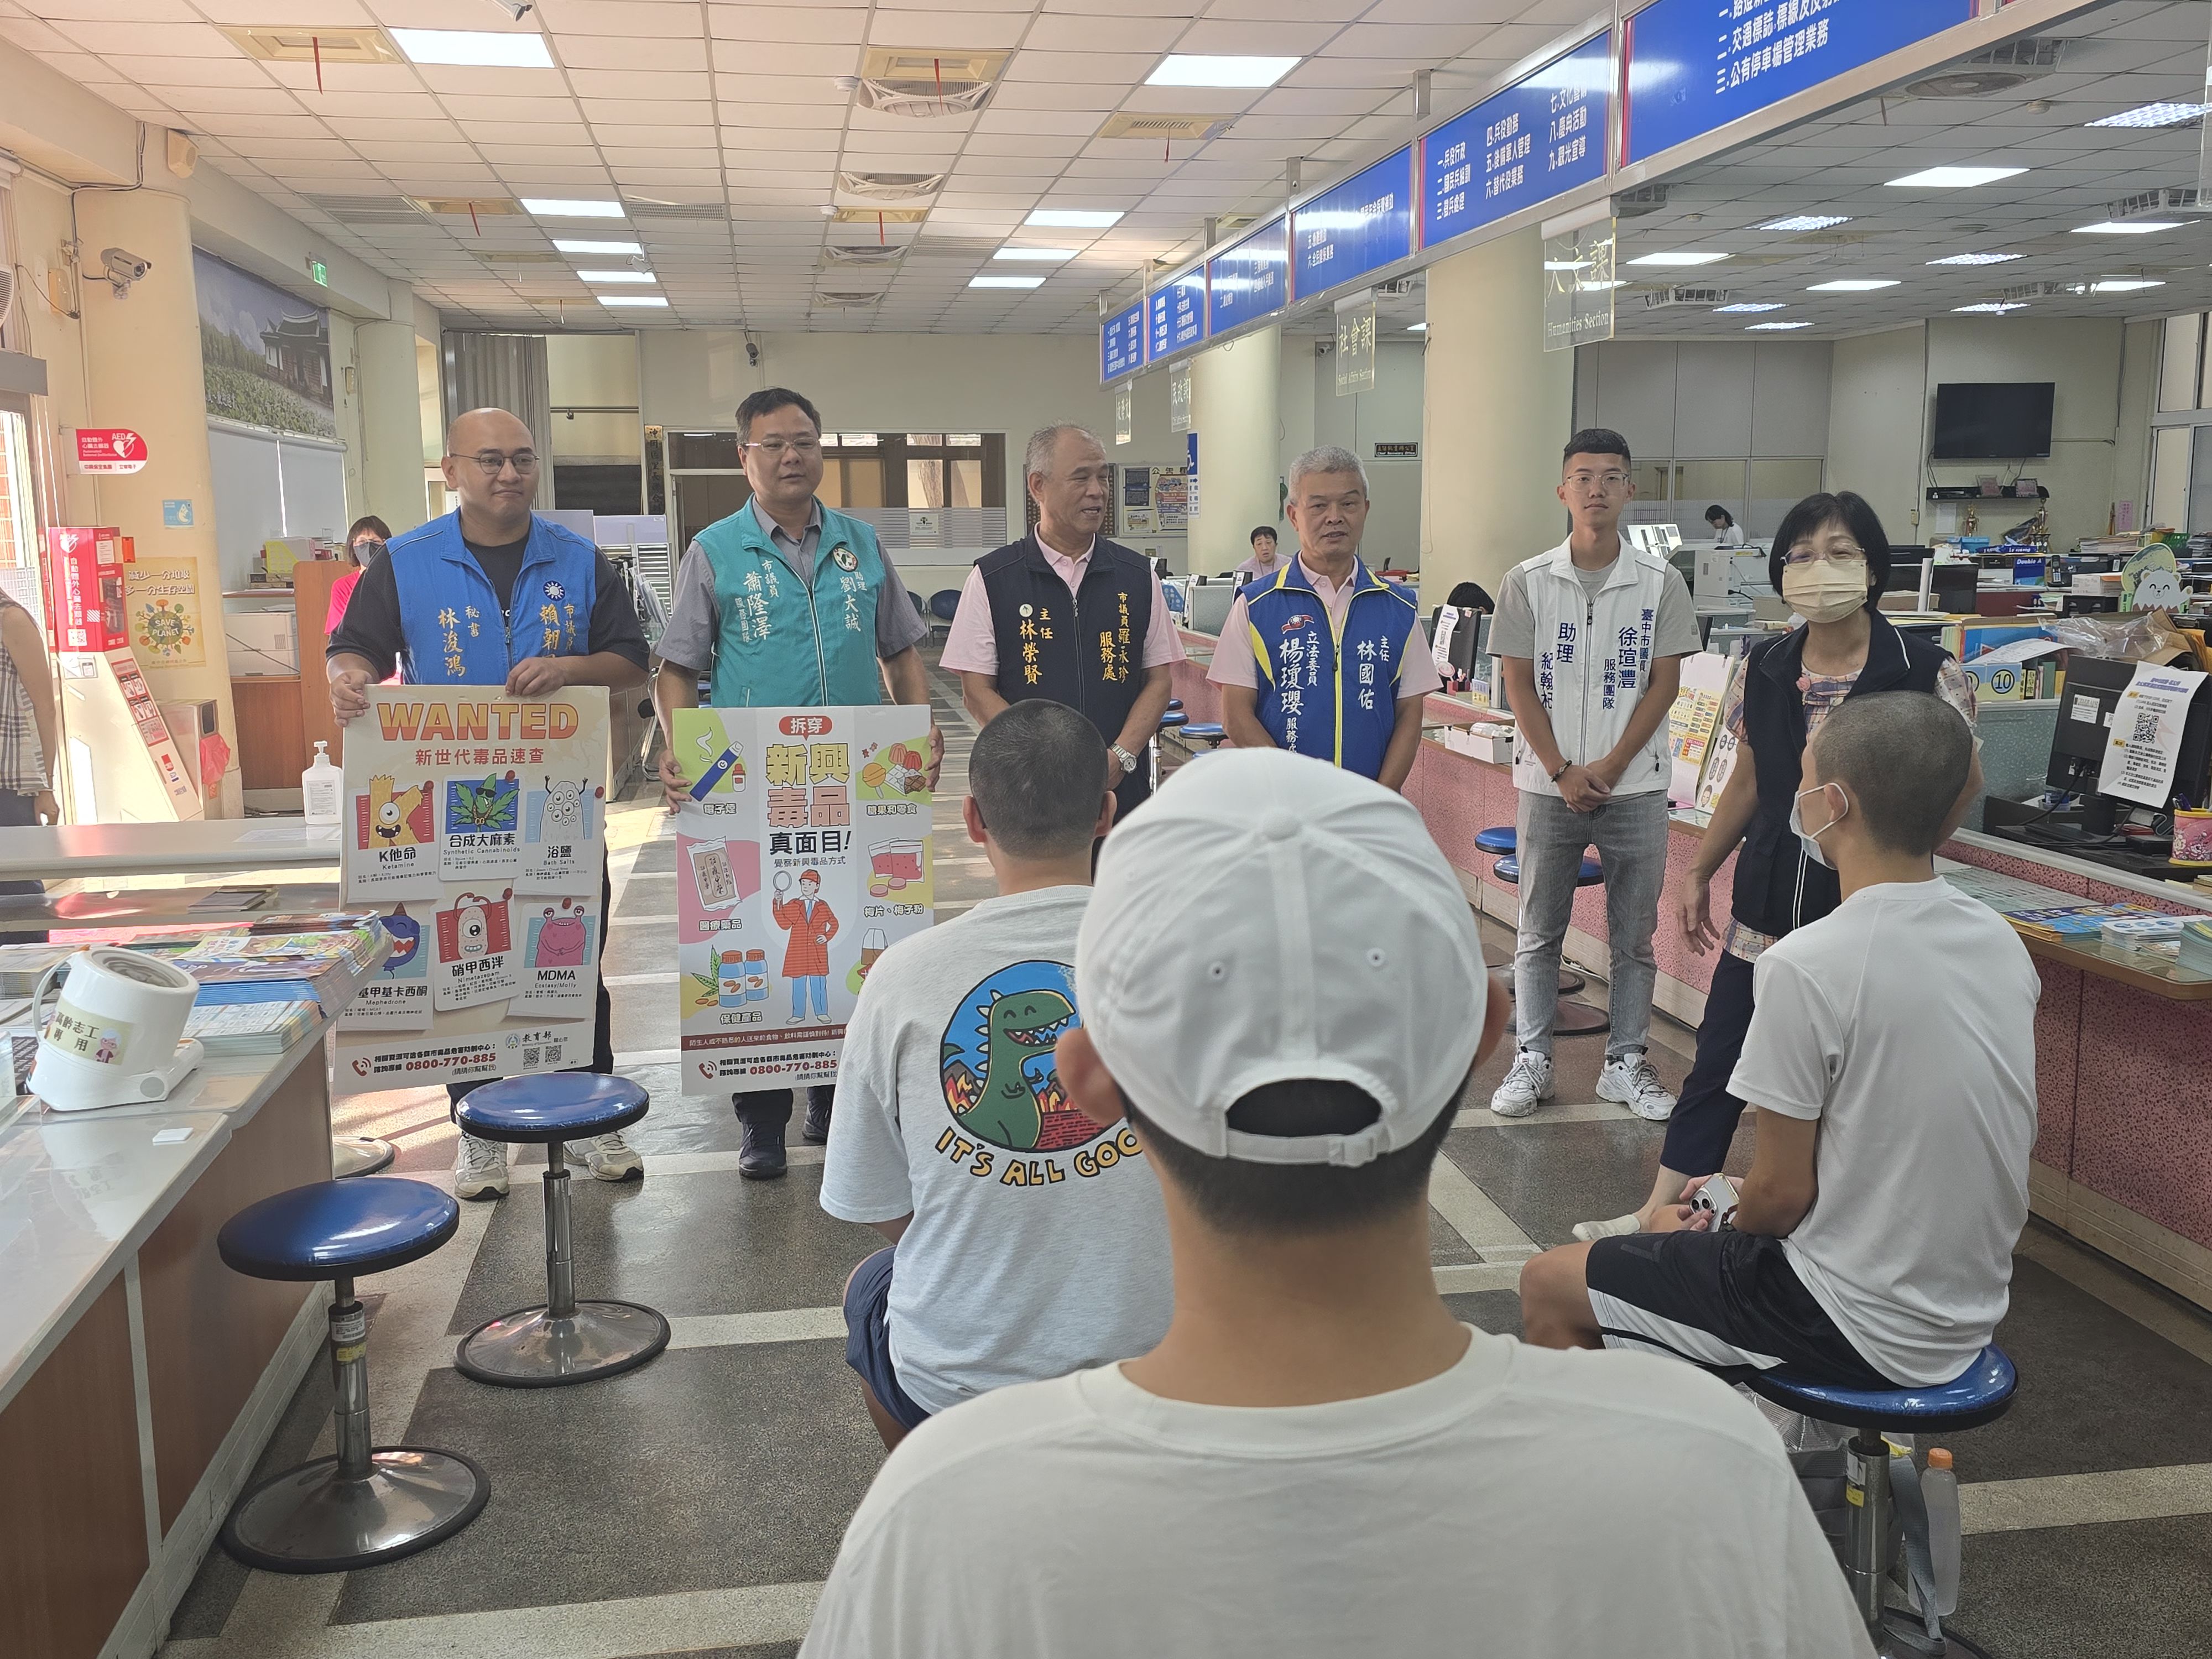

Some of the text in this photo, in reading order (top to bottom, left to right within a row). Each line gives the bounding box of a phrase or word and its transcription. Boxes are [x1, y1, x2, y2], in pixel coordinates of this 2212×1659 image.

[1547, 310, 1609, 337] Humanities Section
[1339, 317, 1372, 359] 社會課
[111, 432, 126, 441] AED
[761, 559, 780, 598] 市議員
[743, 571, 773, 640] 蕭隆澤
[839, 576, 862, 633] 劉大誠
[152, 627, 180, 637] PLANET
[154, 618, 176, 627] SAVE
[465, 604, 481, 638] 秘書
[539, 603, 561, 659] 賴朝
[564, 603, 577, 651] 市議員
[1039, 607, 1054, 640] 主任
[437, 607, 467, 678] 林浚鴻
[1019, 619, 1043, 685] 林榮賢
[1379, 635, 1390, 662] 主任
[1556, 622, 1577, 664] 助理
[1099, 631, 1118, 682] 服務處
[1306, 630, 1321, 687] 立法委員
[1357, 639, 1378, 710] 林國佑
[1602, 658, 1616, 710] 服務團隊
[1995, 673, 2012, 690] 10
[377, 702, 579, 741] WANTED
[790, 717, 823, 734] 拆穿
[415, 748, 545, 767] 新世代毒品速查
[765, 742, 851, 786] 新興
[702, 803, 737, 816] 電子煙
[767, 785, 851, 828] 毒品
[866, 803, 917, 816] 糖果和零食
[442, 846, 521, 857] Synthetic Cannabinoids
[448, 832, 516, 848] 合成大麻素
[547, 844, 572, 859] 浴鹽
[769, 830, 852, 855] 真面目!
[379, 847, 417, 864] K他命
[382, 861, 415, 870] Ketamine
[451, 954, 505, 978] 硝甲西泮
[457, 971, 500, 984] Nimetazepam
[536, 969, 577, 982] MDMA
[55, 1011, 100, 1040] 高齡志工
[719, 1011, 763, 1025] 保健產品
[74, 1037, 89, 1052] 用
[405, 1052, 497, 1071] 0800-770-885
[749, 1059, 838, 1075] 0800-770-885
[935, 1125, 995, 1178] IT'S
[999, 1158, 1066, 1187] ALL
